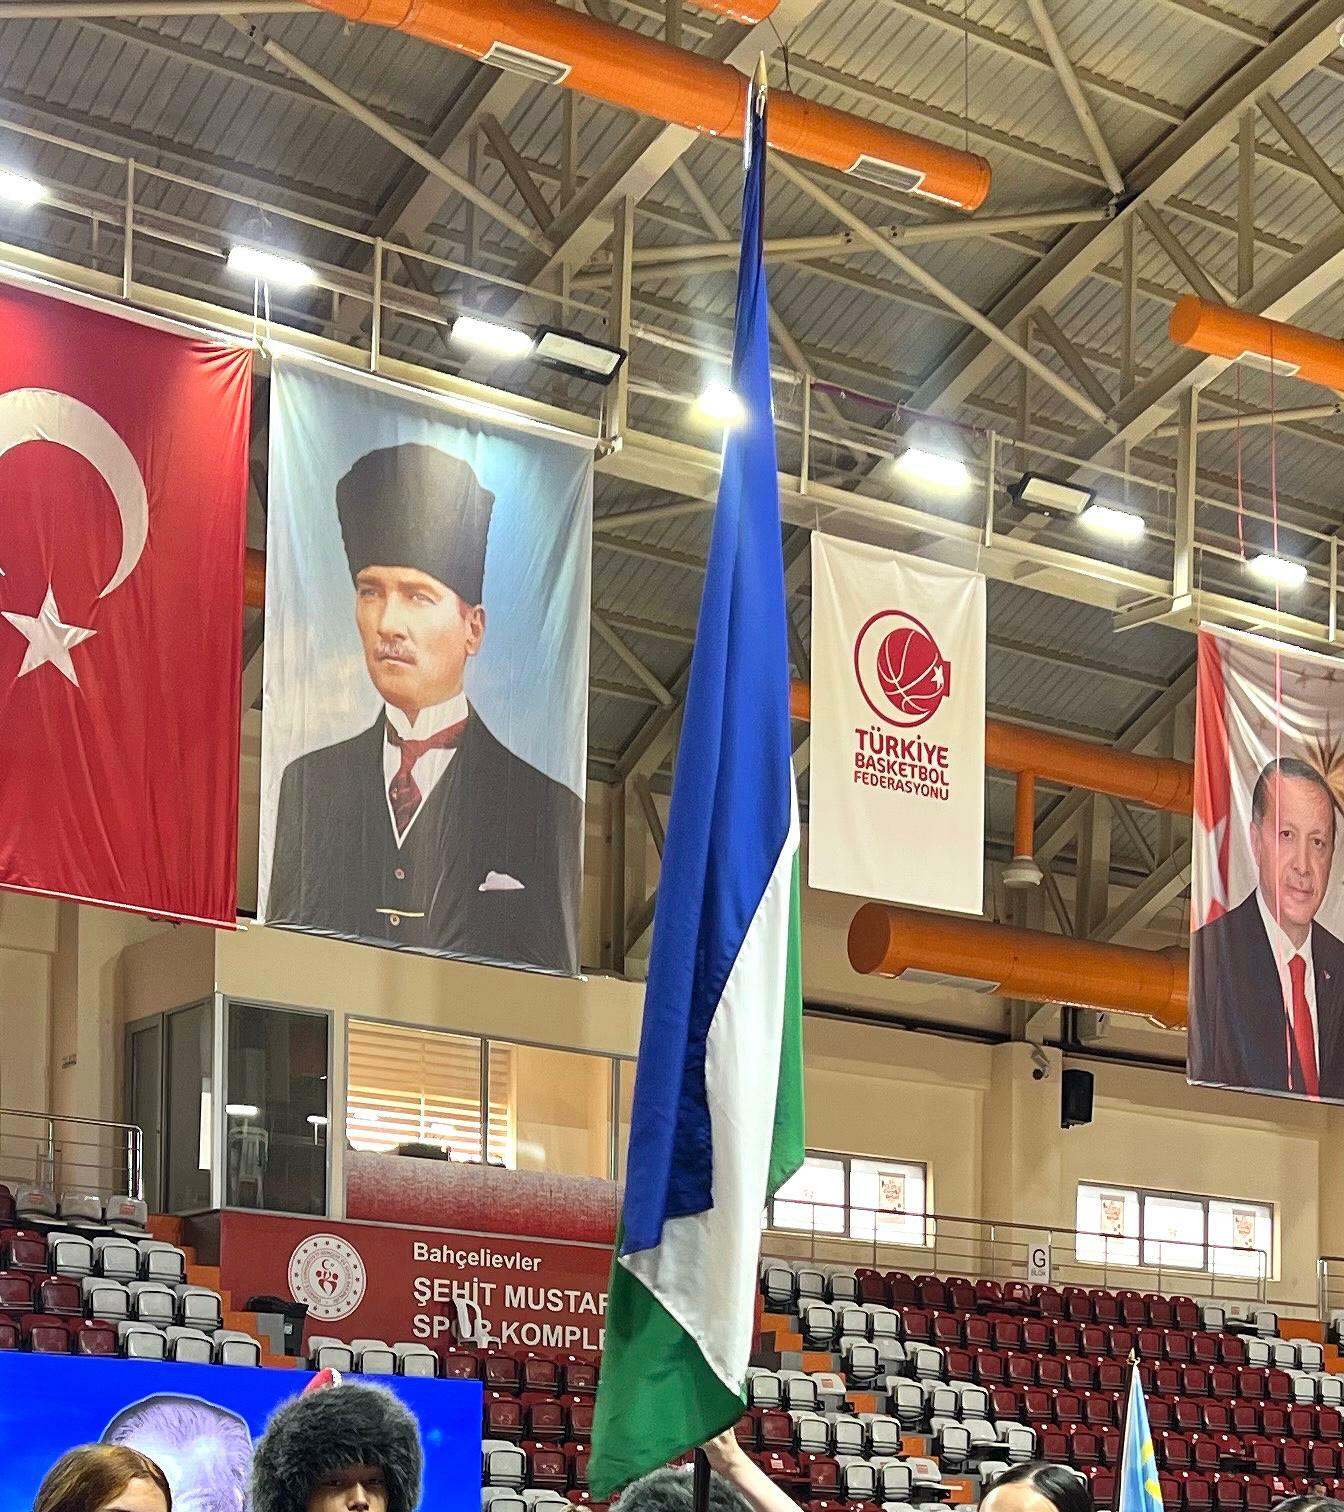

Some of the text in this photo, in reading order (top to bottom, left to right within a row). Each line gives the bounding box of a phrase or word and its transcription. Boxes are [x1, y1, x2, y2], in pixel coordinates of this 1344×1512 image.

[855, 725, 948, 769] TÜRKİYE
[855, 752, 949, 786] BASKETBOL
[854, 770, 949, 800] FEDERASYONU
[413, 1242, 542, 1271] Bahçelievler
[1033, 1249, 1046, 1268] G
[413, 1277, 496, 1307] ŞEHİT
[413, 1314, 493, 1340] SPR
